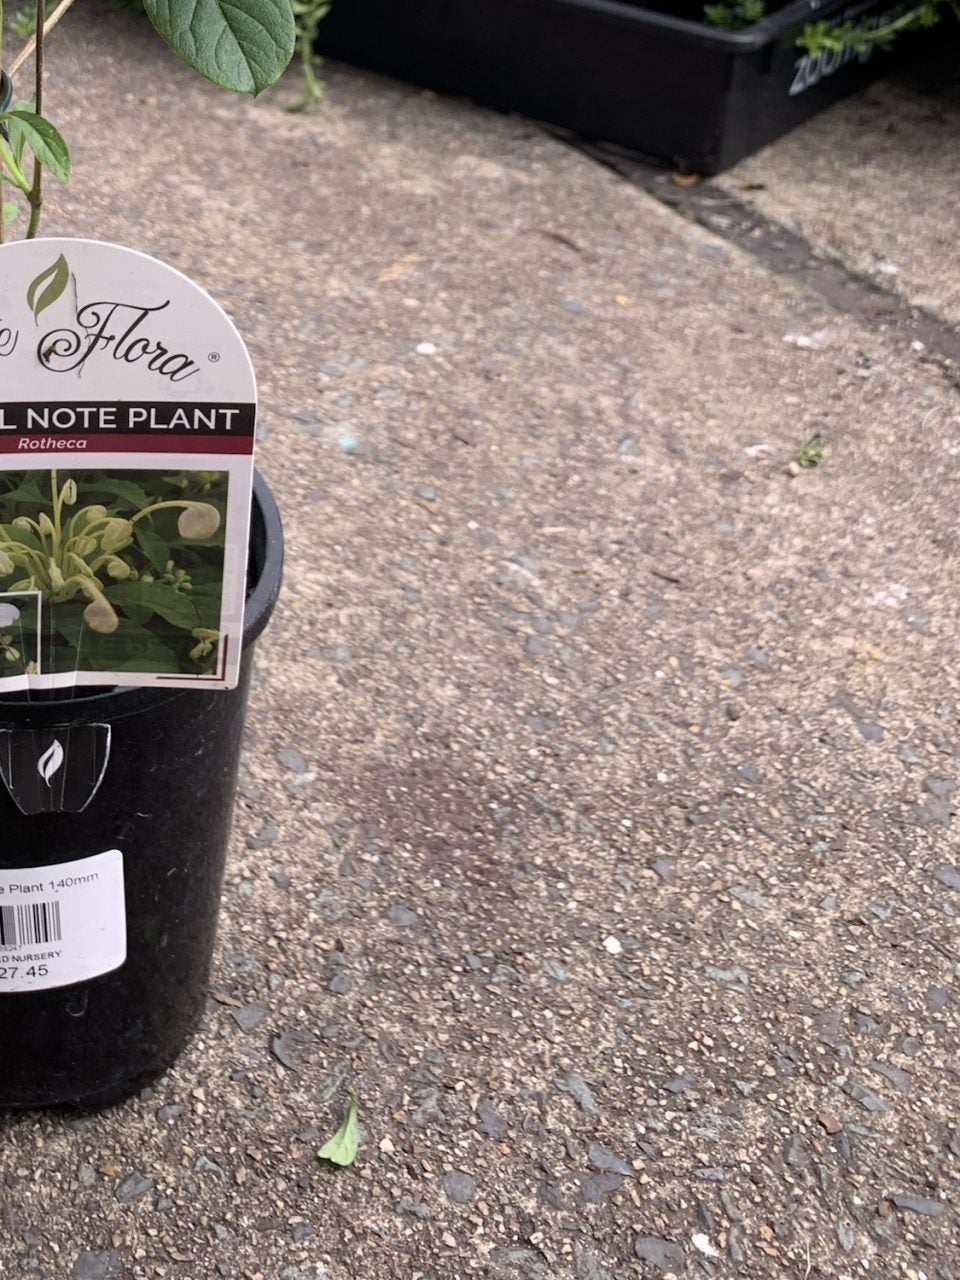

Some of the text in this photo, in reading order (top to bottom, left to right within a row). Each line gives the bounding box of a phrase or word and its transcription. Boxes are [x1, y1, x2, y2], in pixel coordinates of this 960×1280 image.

[37, 300, 200, 382] Flora
[26, 407, 117, 430] NOTE
[128, 407, 240, 430] PLANT
[17, 437, 88, 450] Rotheca
[9, 882, 44, 894] Plant
[48, 872, 99, 890] 140mm
[12, 949, 62, 962] NURSERY
